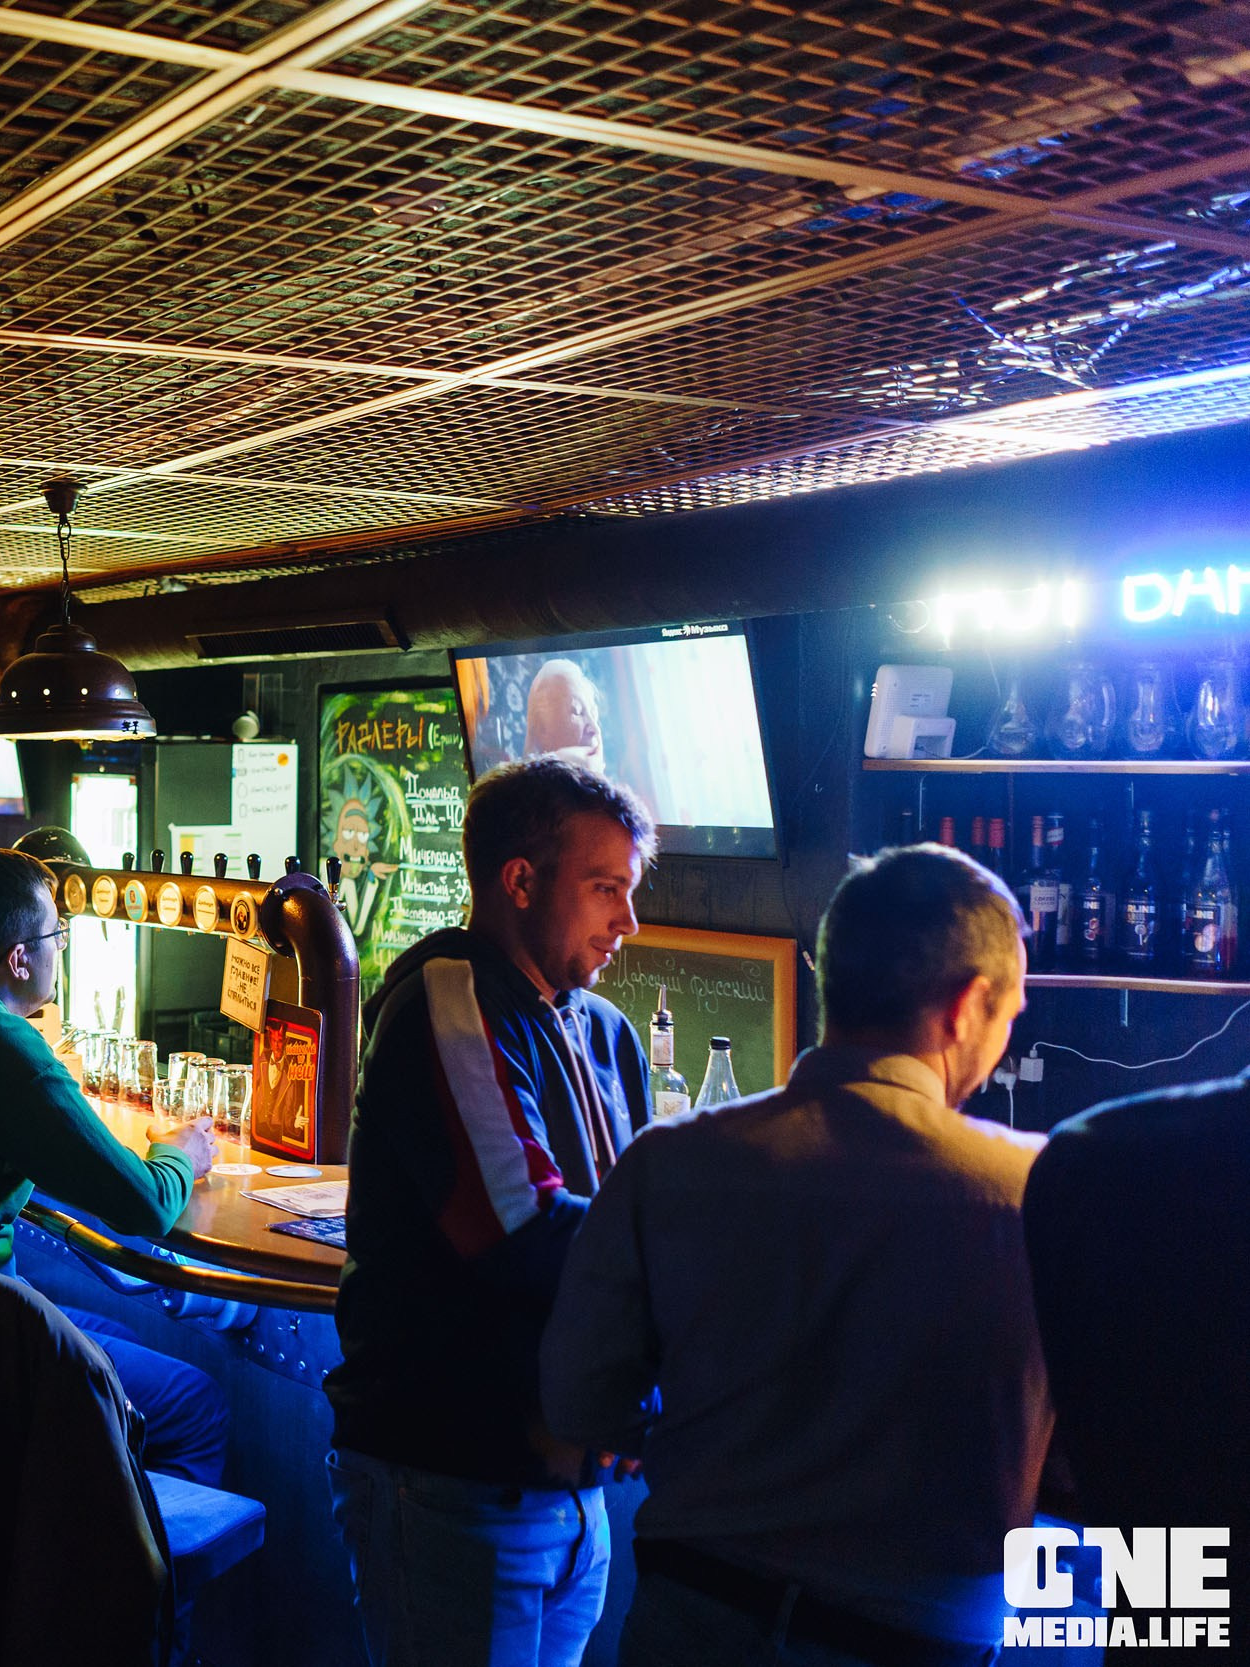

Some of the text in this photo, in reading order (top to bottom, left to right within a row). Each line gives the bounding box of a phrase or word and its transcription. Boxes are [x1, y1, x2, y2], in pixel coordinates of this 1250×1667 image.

[691, 624, 729, 636] Музыка
[336, 716, 424, 754] РАДЛЕРЫ
[231, 955, 250, 969] МОЖНО
[239, 982, 247, 994] НЕ
